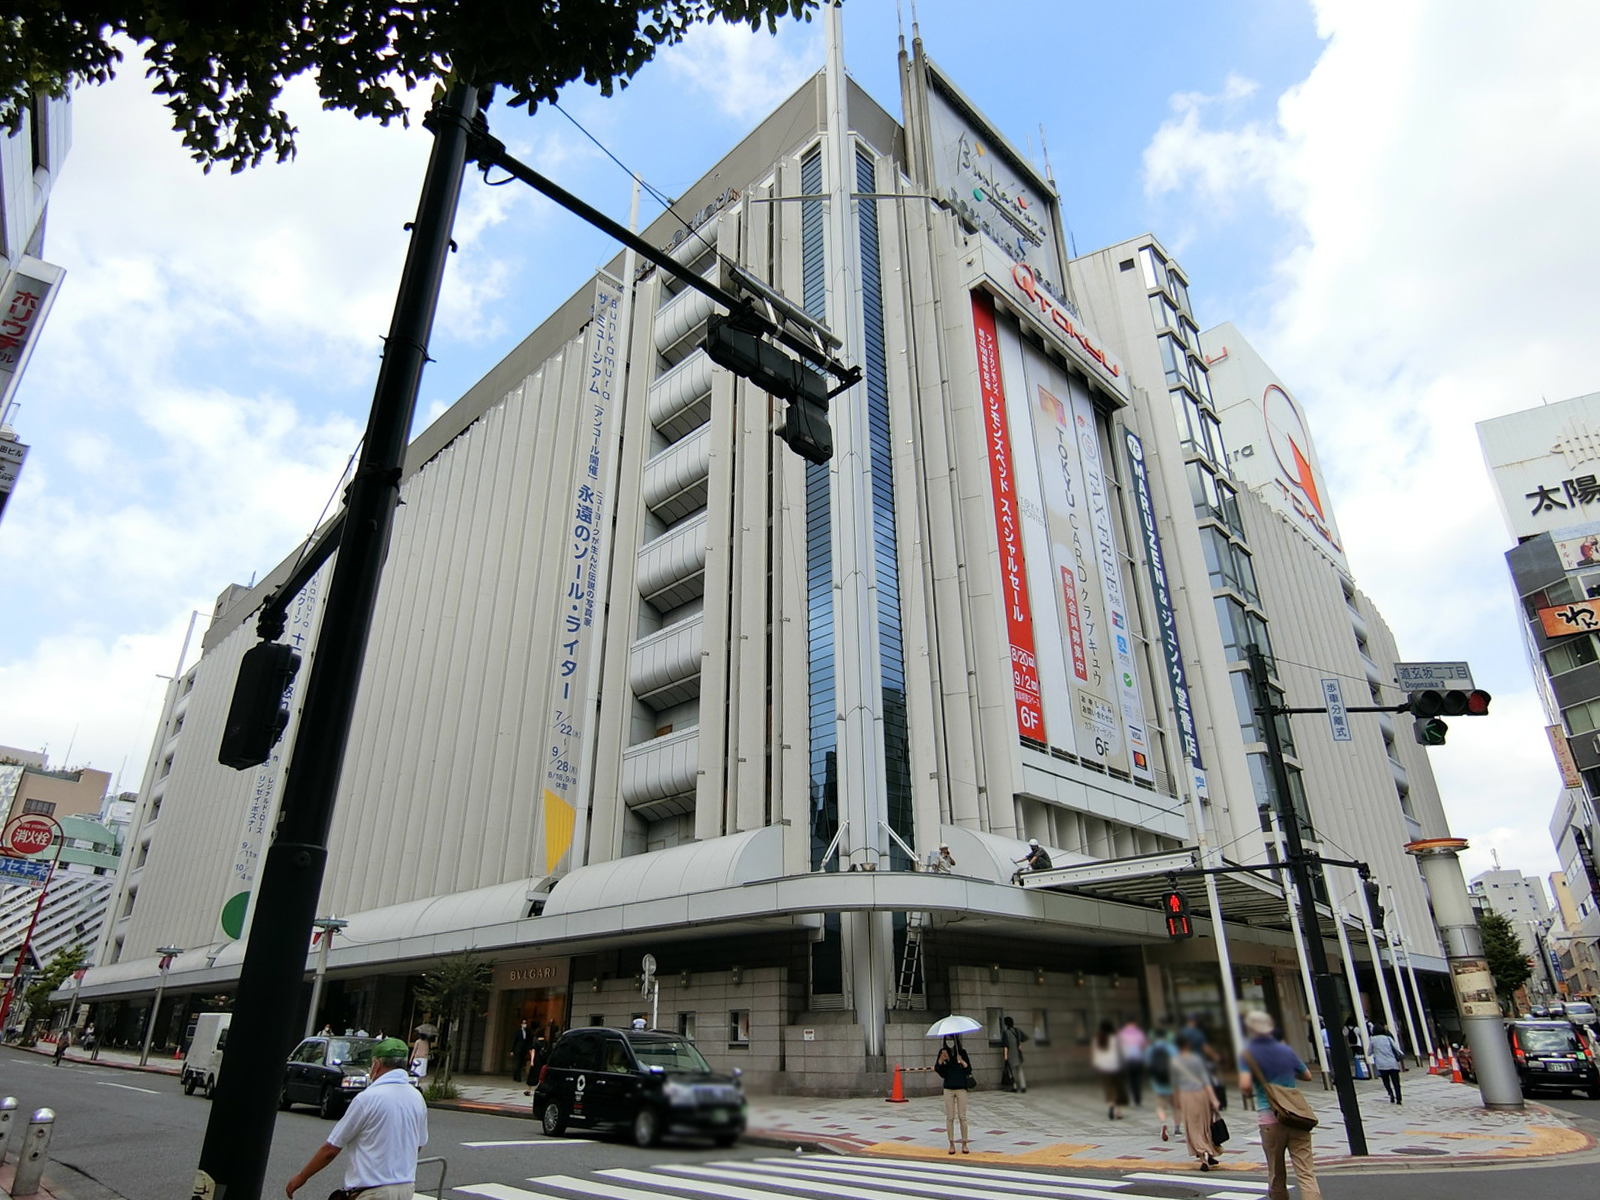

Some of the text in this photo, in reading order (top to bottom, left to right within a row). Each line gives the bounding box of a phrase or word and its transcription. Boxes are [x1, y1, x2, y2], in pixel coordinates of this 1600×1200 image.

[602, 299, 617, 400] Bunkamura
[1034, 290, 1118, 378] TOKYU
[1056, 427, 1088, 583] TOKYU CARD
[1133, 460, 1164, 588] MARUZEN
[1525, 474, 1600, 517] 太陽
[1001, 498, 1023, 622] スペシャルセール
[1088, 472, 1118, 593] TAX-FREE
[561, 484, 594, 700] 永遠のソール・ライター
[1161, 611, 1198, 759] ジュンク堂書店
[1400, 667, 1468, 680] 道玄坂二丁目
[1405, 680, 1446, 689] Dogenzaka 2
[1020, 706, 1039, 730] 6F
[1326, 683, 1347, 738] 歩車分離式
[1095, 736, 1109, 757] 6F
[14, 829, 49, 845] 消火栓
[510, 967, 557, 981] BVLGARI
